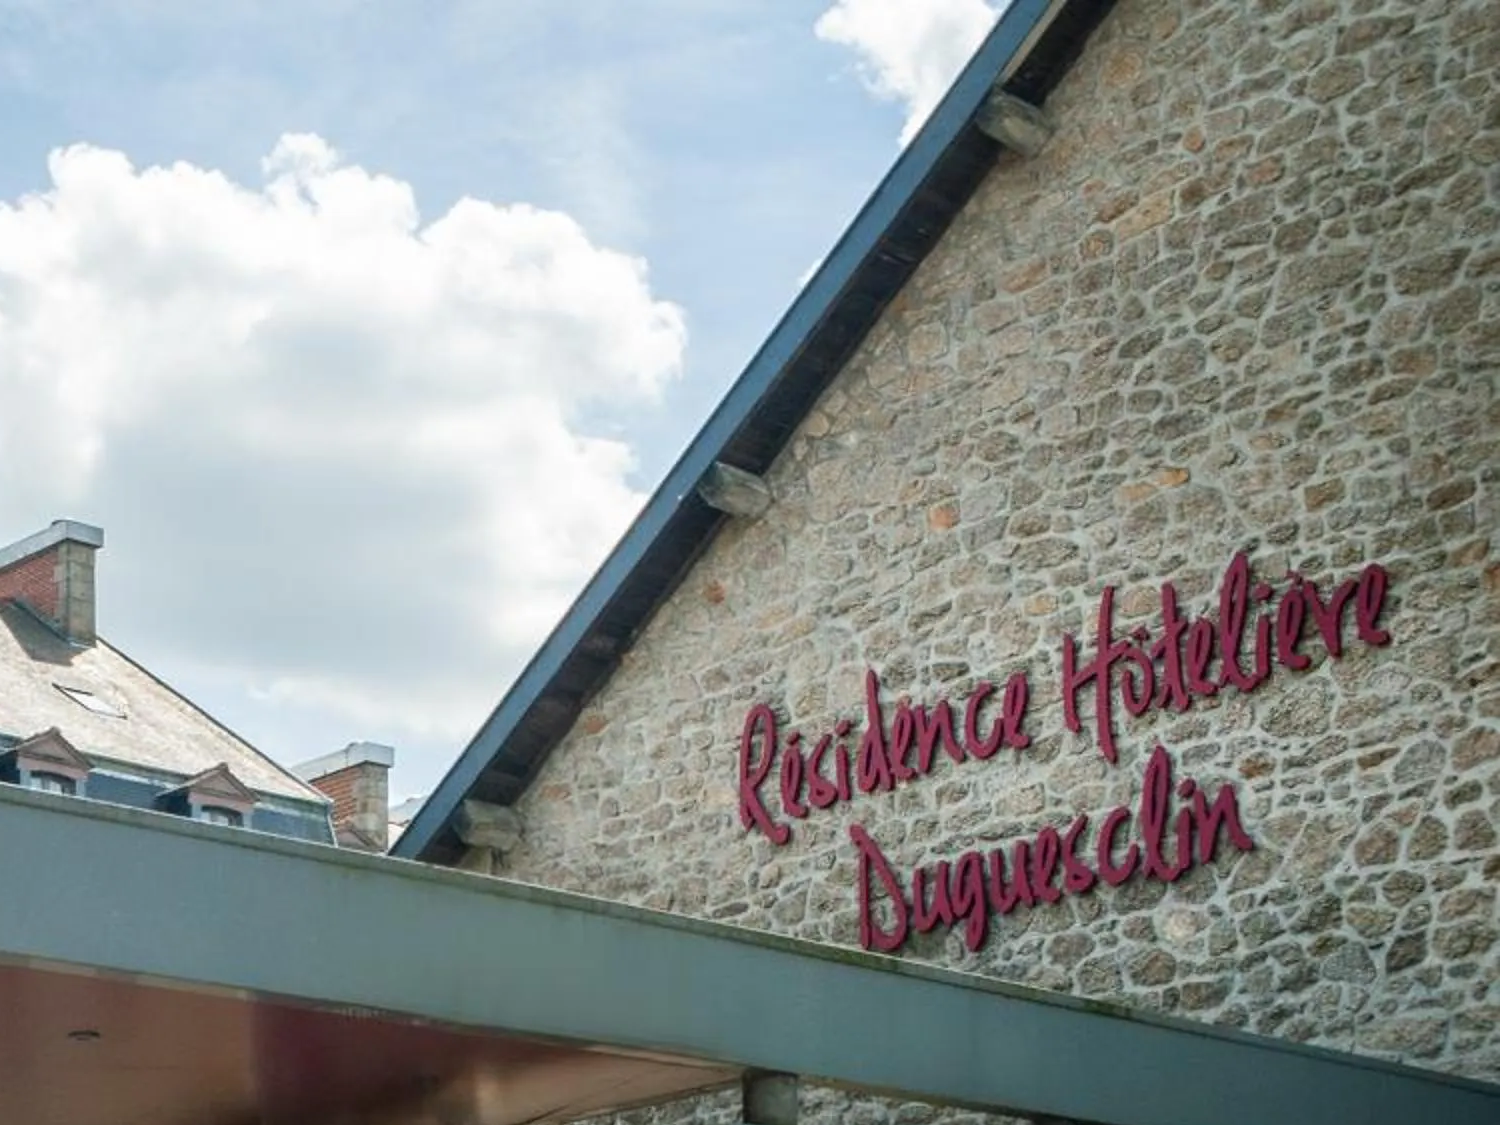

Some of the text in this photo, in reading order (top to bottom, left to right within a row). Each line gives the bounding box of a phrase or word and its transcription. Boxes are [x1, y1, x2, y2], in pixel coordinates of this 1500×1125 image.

[739, 551, 1392, 846] Résidence Hôtelière
[849, 744, 1254, 953] Duguesclin
